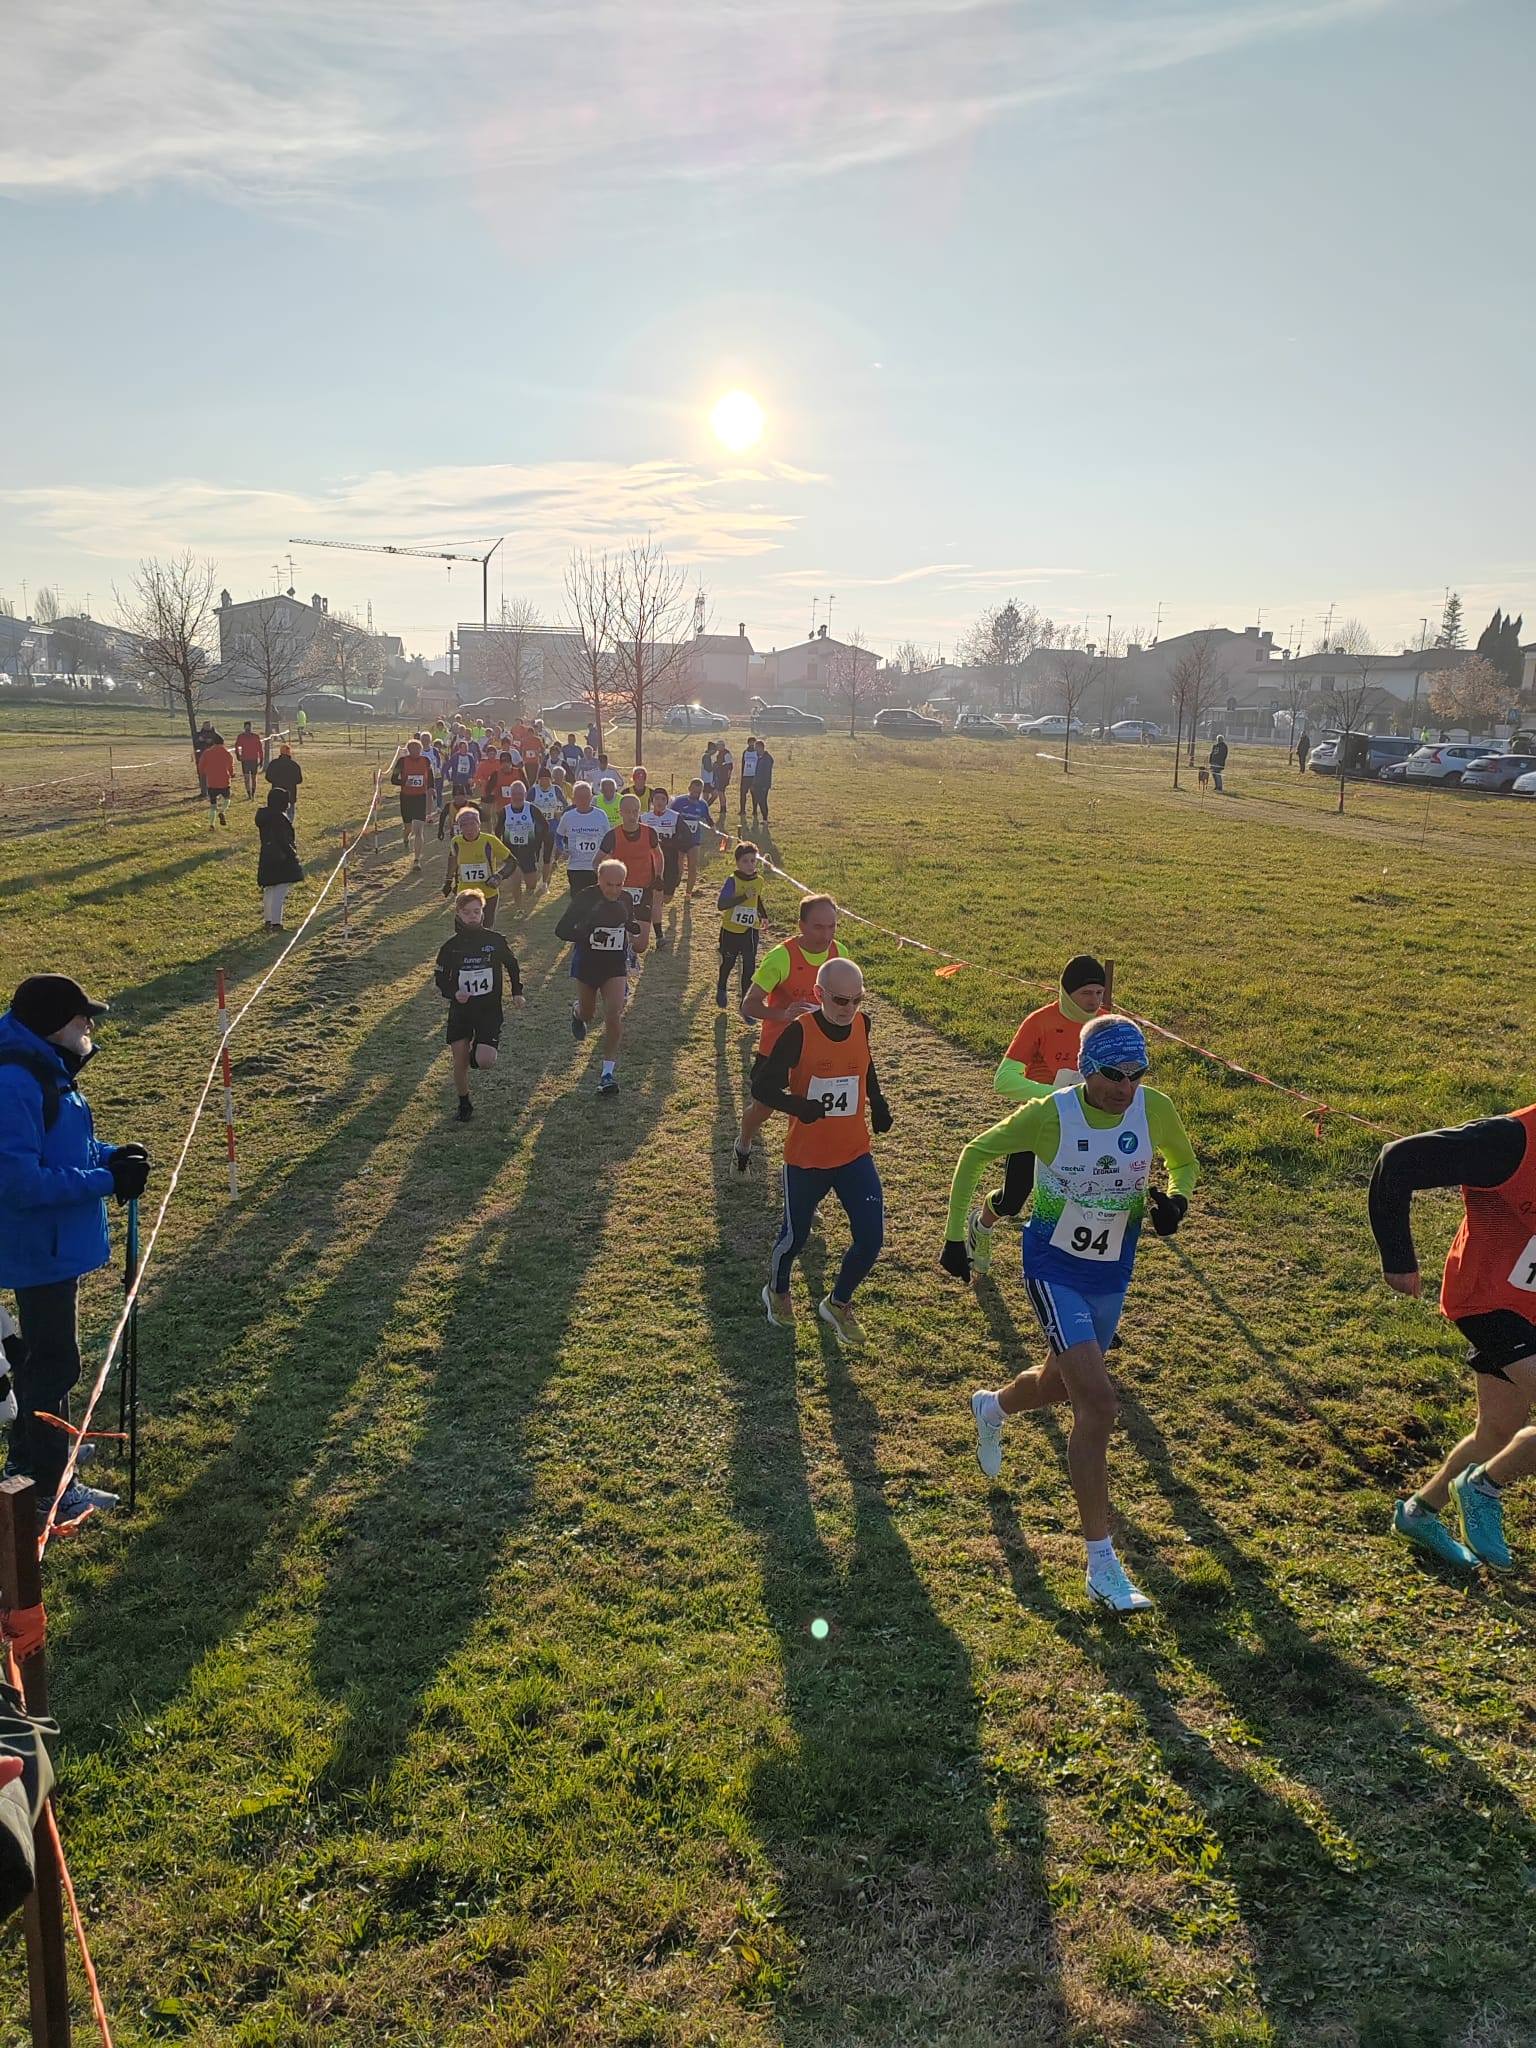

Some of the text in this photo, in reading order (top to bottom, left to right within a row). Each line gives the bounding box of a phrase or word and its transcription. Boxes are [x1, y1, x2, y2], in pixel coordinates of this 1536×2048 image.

[579, 841, 596, 851] 170
[464, 870, 485, 881] 175
[735, 913, 754, 925] 150
[464, 978, 489, 993] 114
[821, 1091, 848, 1112] 84
[1070, 1226, 1110, 1255] 94
